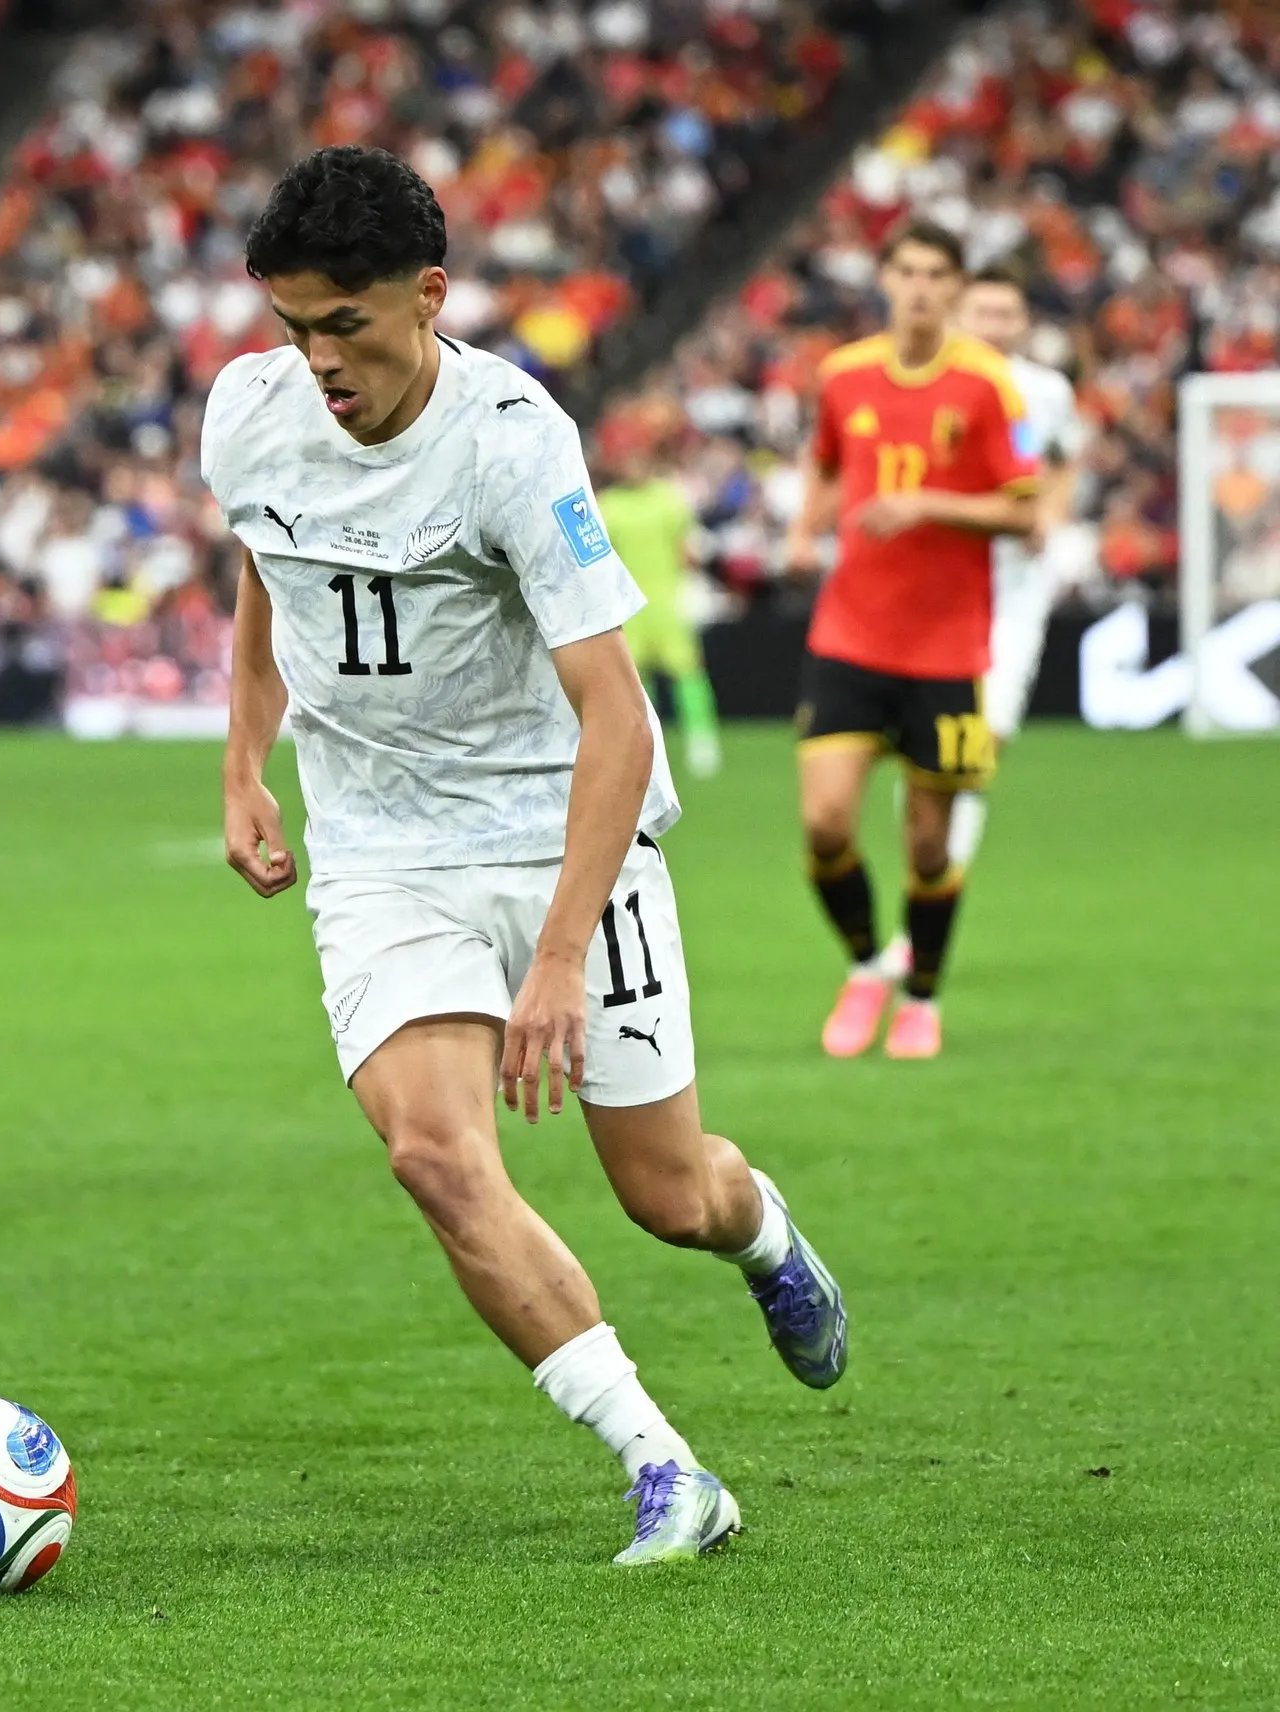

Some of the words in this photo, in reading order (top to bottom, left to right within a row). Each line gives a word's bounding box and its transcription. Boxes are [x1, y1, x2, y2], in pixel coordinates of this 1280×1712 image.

[342, 525, 355, 535] NZL
[366, 530, 381, 540] BEL
[327, 573, 413, 676] 11
[601, 890, 663, 1008] 11
